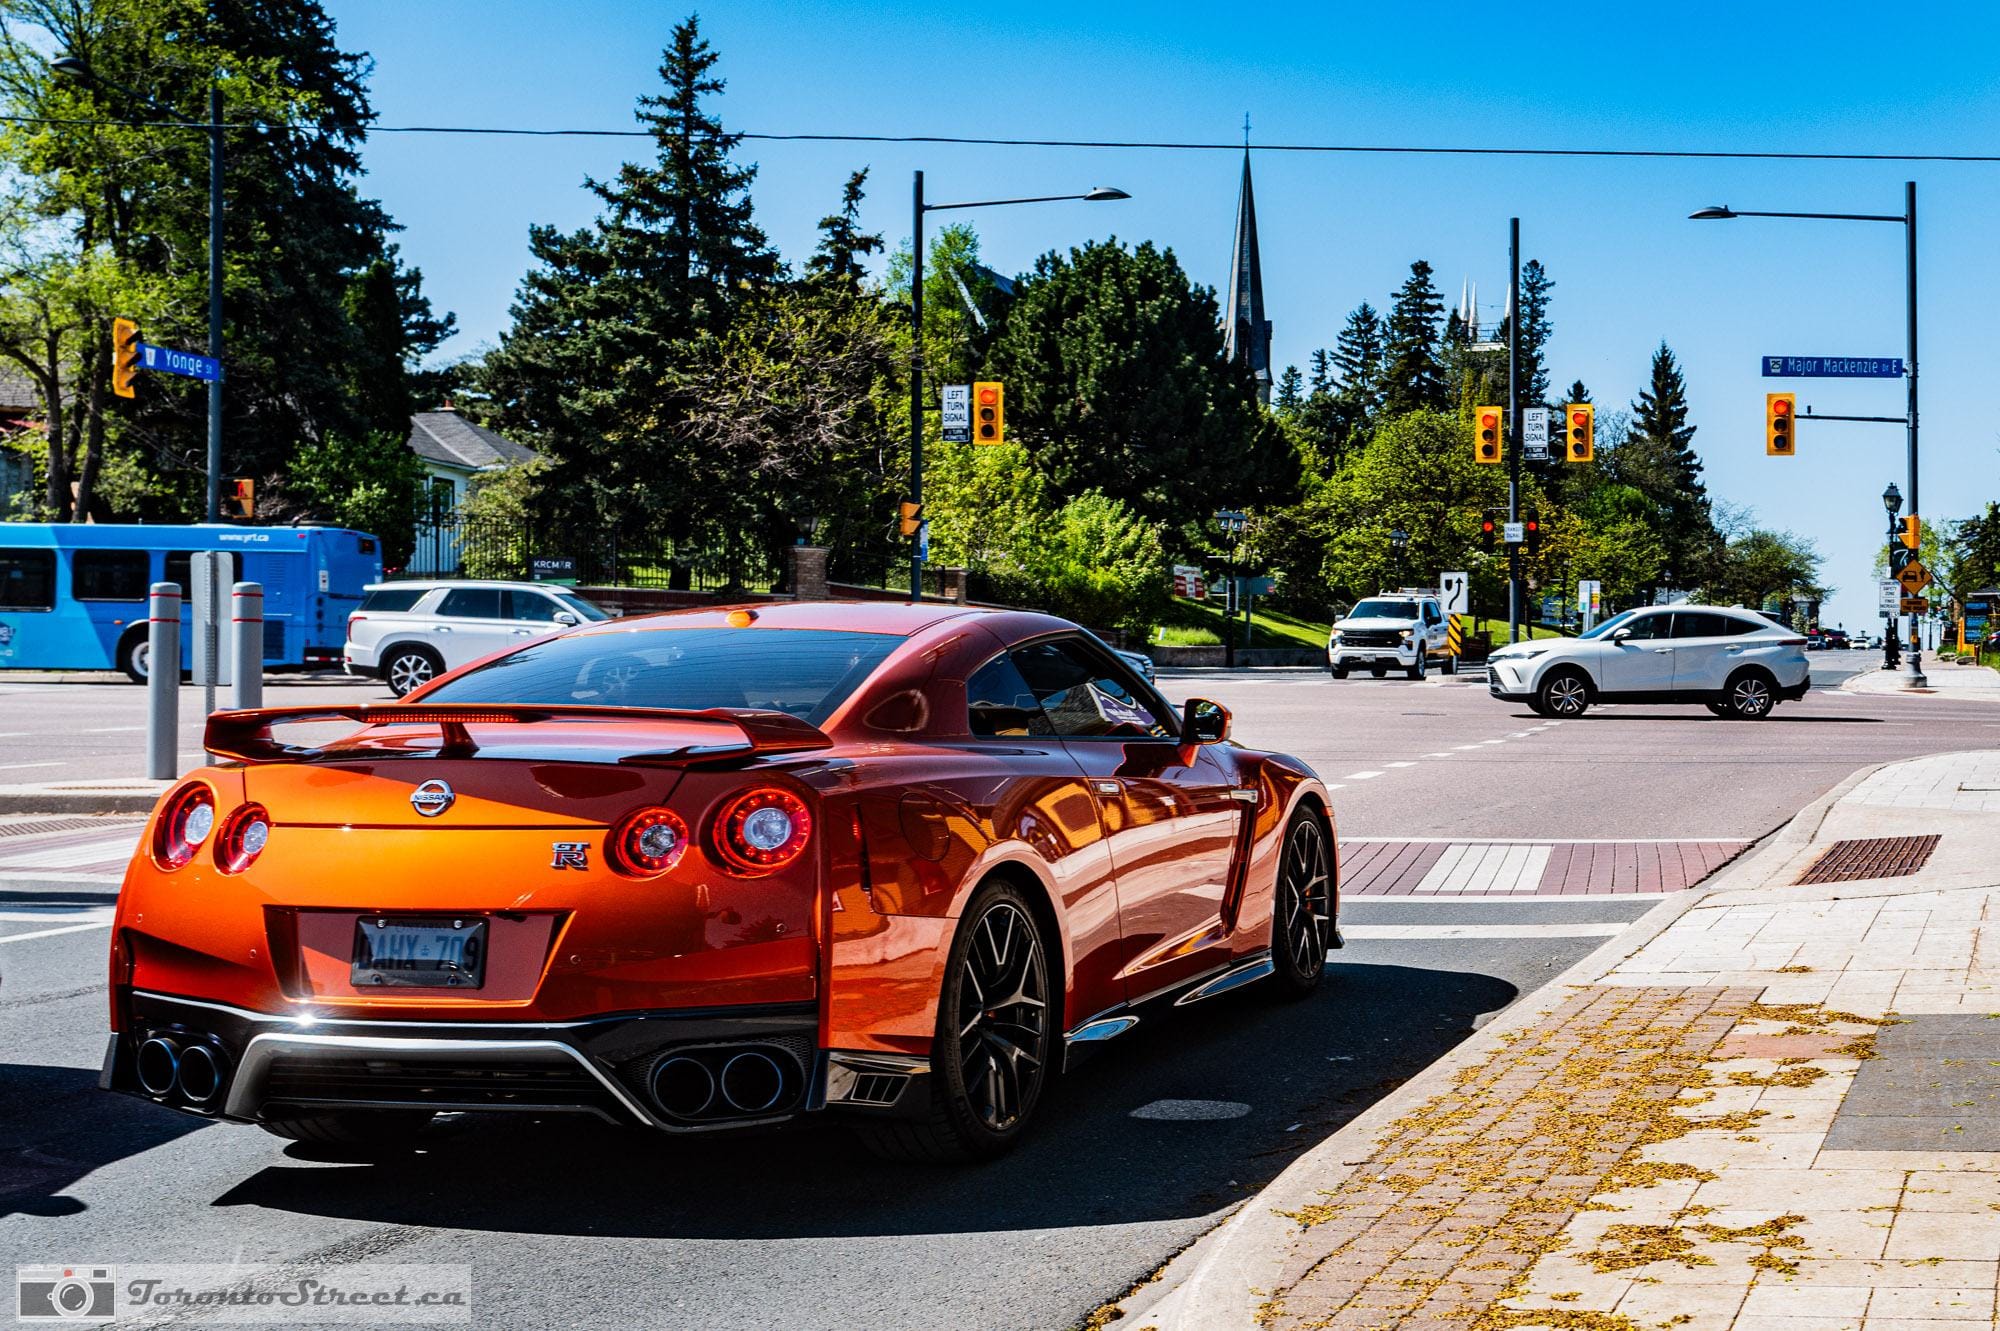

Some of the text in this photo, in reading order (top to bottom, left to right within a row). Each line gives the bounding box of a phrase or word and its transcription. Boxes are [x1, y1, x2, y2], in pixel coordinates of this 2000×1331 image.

[165, 349, 202, 376] Yonge
[1771, 360, 1780, 370] 25
[1787, 358, 1818, 376] Major
[1823, 359, 1878, 373] Mackenzie
[1892, 360, 1897, 374] E
[947, 390, 964, 400] LEFT
[947, 401, 965, 411] TURN
[944, 412, 967, 422] SIGNAL
[1527, 412, 1544, 421] LEFT
[1527, 422, 1544, 431] TURN
[1524, 433, 1546, 442] SIGNAL
[414, 794, 451, 802] NISSAN
[435, 935, 480, 971] 709
